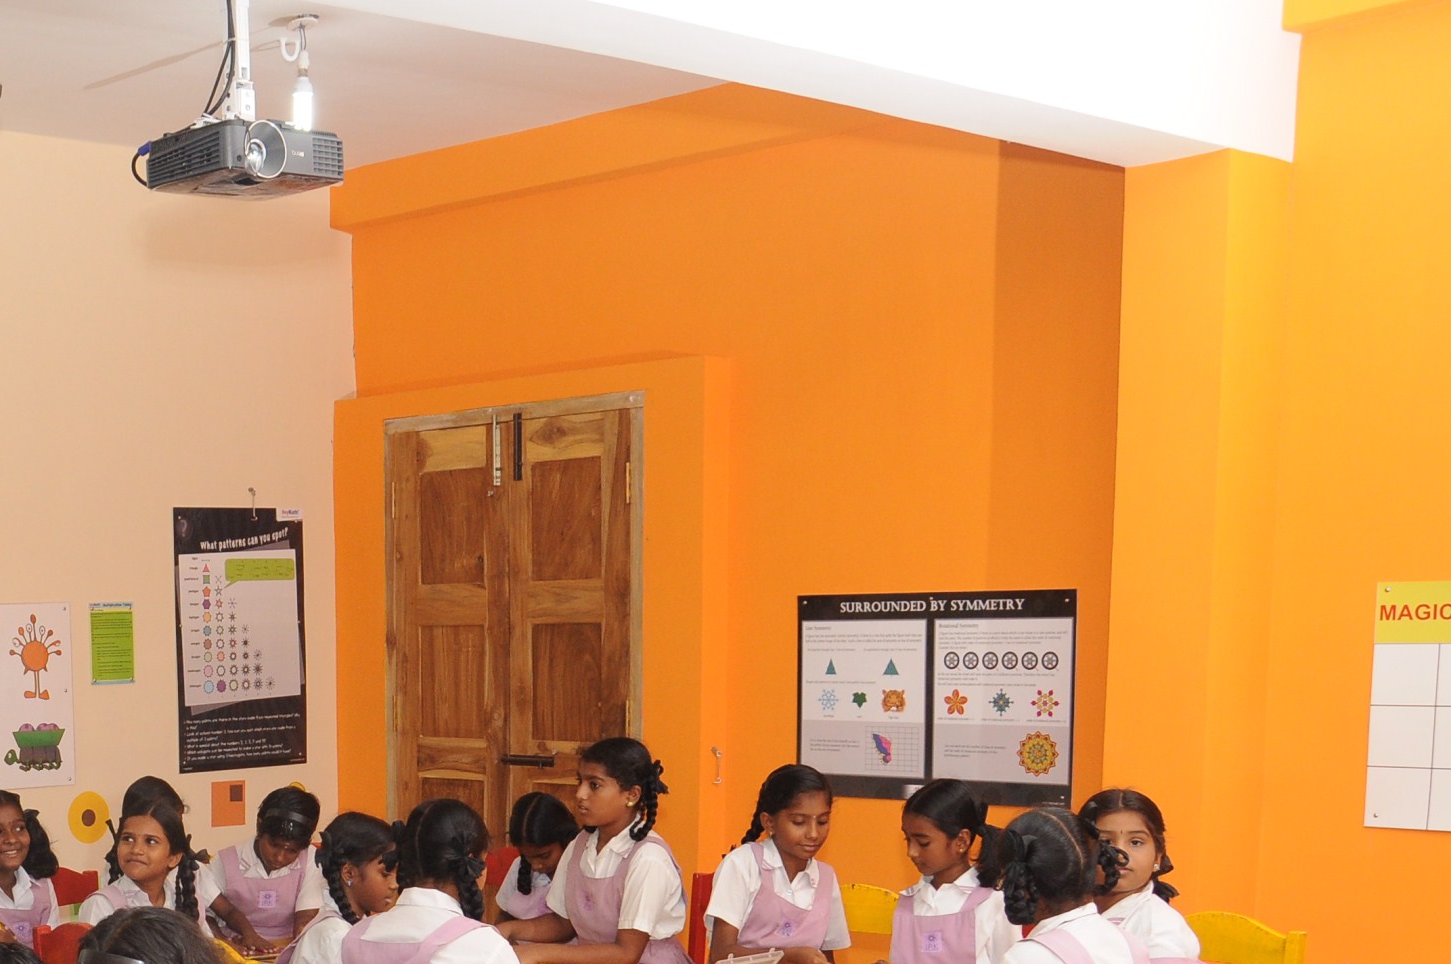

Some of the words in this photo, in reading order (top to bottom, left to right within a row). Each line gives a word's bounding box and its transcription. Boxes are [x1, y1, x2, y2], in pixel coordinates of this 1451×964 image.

[200, 540, 217, 550] What
[218, 538, 246, 552] patterns
[247, 535, 258, 546] can
[259, 532, 270, 545] you
[271, 526, 289, 541] spot?
[840, 600, 926, 614] SURROUNDED
[929, 600, 945, 612] BY
[950, 598, 1025, 612] SYMMETRY
